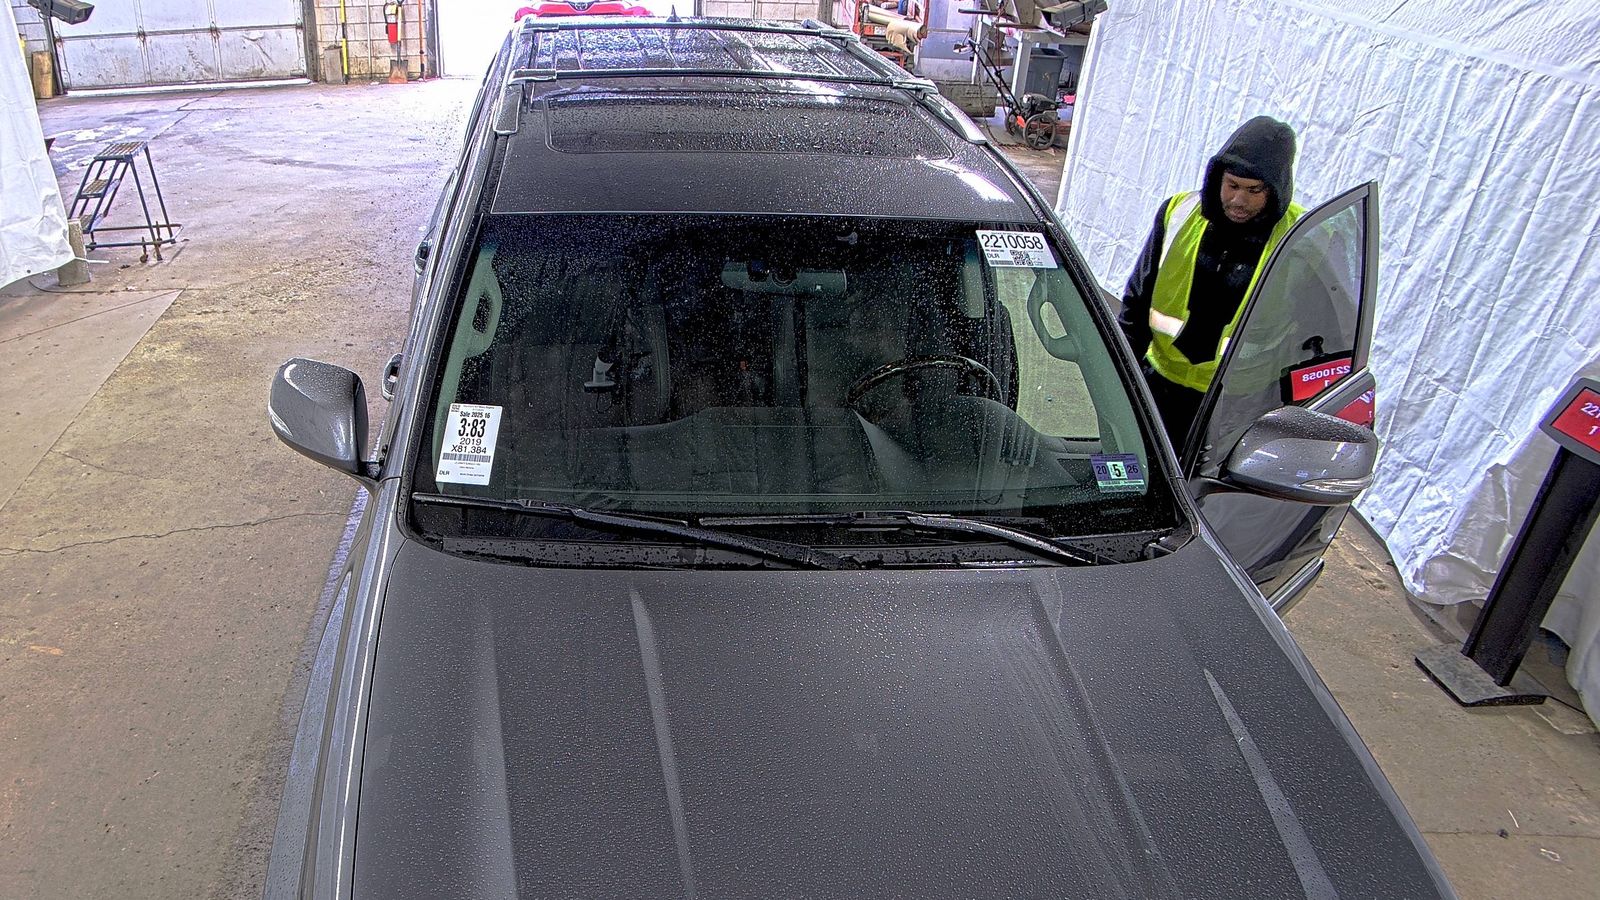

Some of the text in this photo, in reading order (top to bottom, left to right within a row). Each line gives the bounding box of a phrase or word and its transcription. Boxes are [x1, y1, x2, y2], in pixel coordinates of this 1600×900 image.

[982, 234, 1043, 249] 2210058
[1096, 464, 1138, 477] 20 5 26
